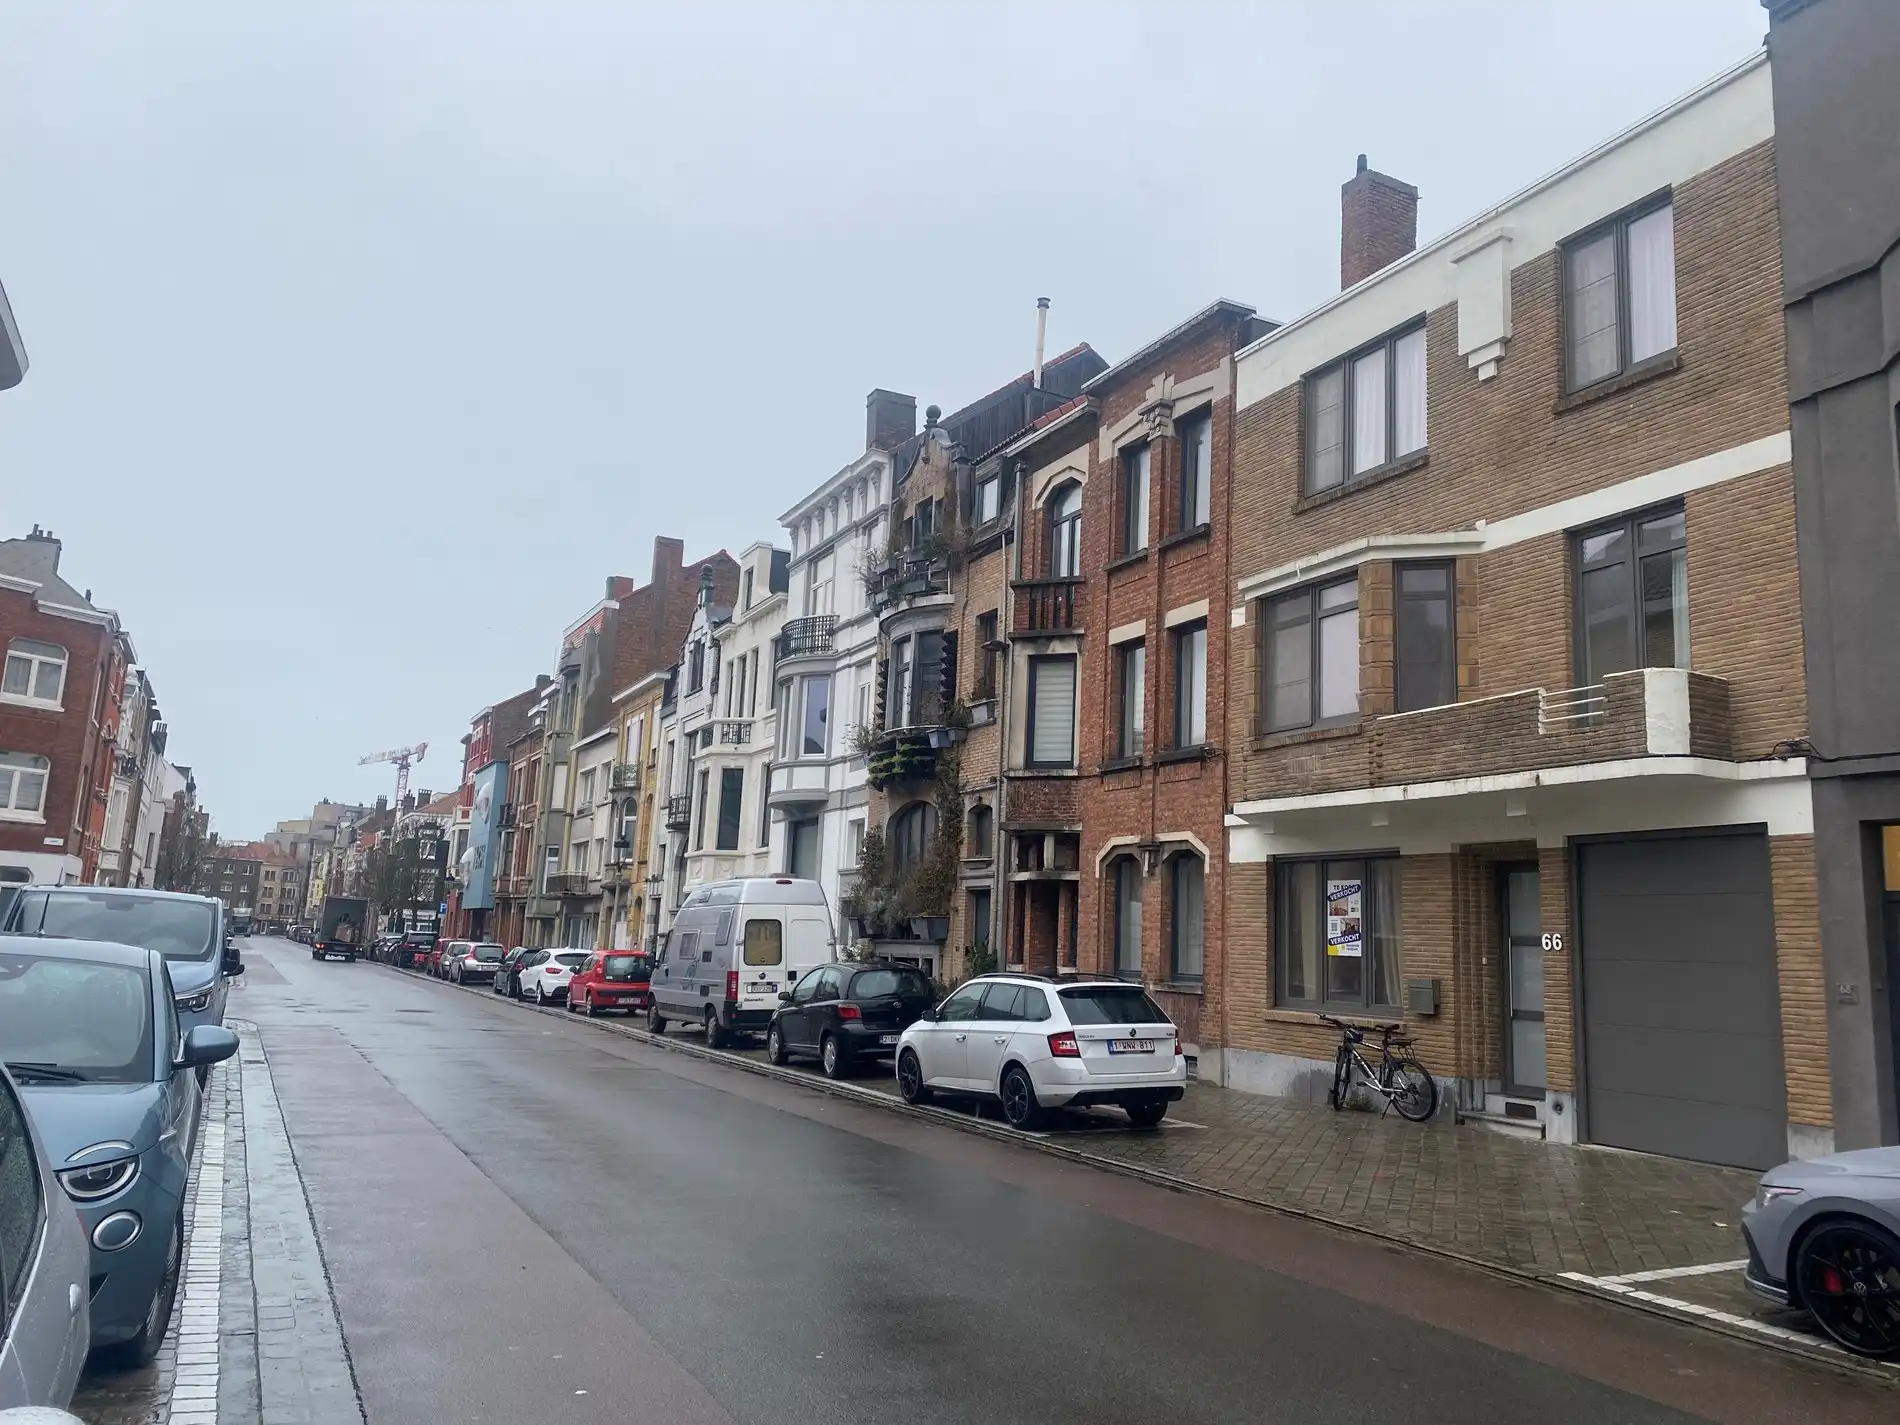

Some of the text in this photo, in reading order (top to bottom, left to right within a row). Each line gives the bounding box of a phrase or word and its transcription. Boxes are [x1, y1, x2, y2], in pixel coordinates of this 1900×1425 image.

[1330, 885, 1359, 900] VERKOCHT
[440, 903, 448, 912] P
[1330, 933, 1359, 944] VERKOCHT
[1541, 933, 1562, 950] 66
